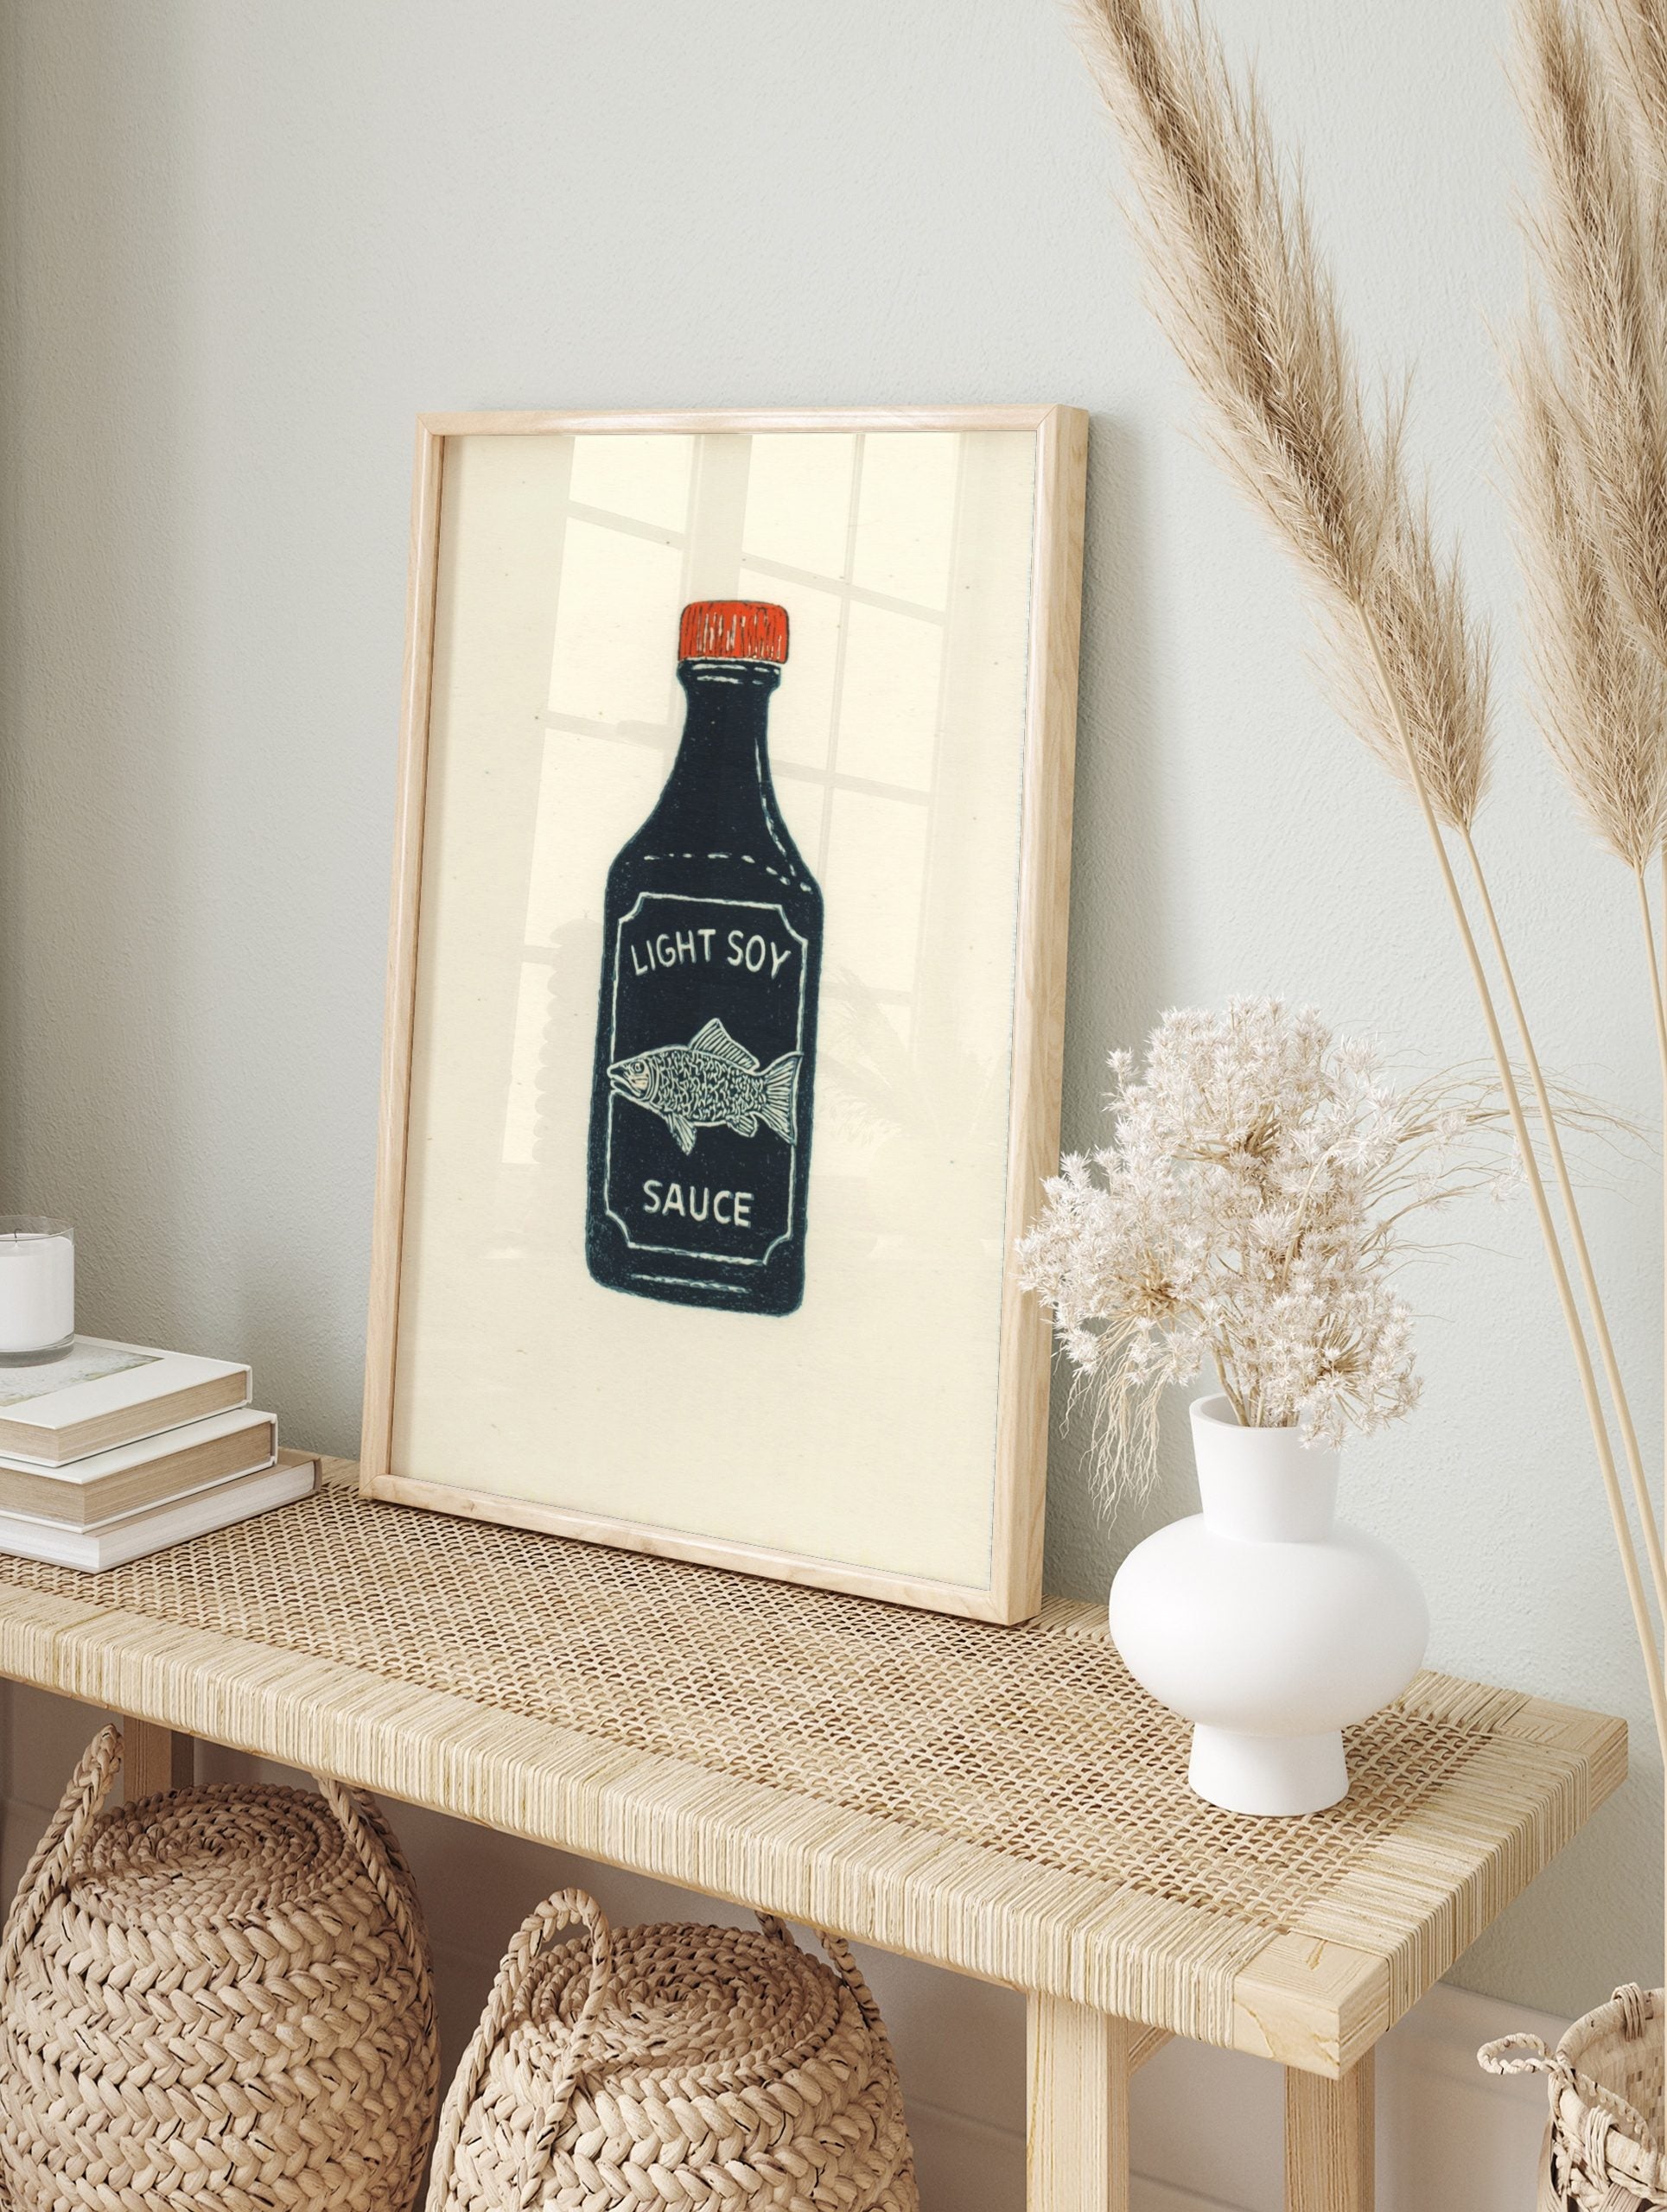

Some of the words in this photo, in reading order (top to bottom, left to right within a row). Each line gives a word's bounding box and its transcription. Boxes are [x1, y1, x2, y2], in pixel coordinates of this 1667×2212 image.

[631, 929, 716, 976] LIGHT
[727, 930, 792, 979] SOY
[643, 1179, 754, 1227] SAUCE
